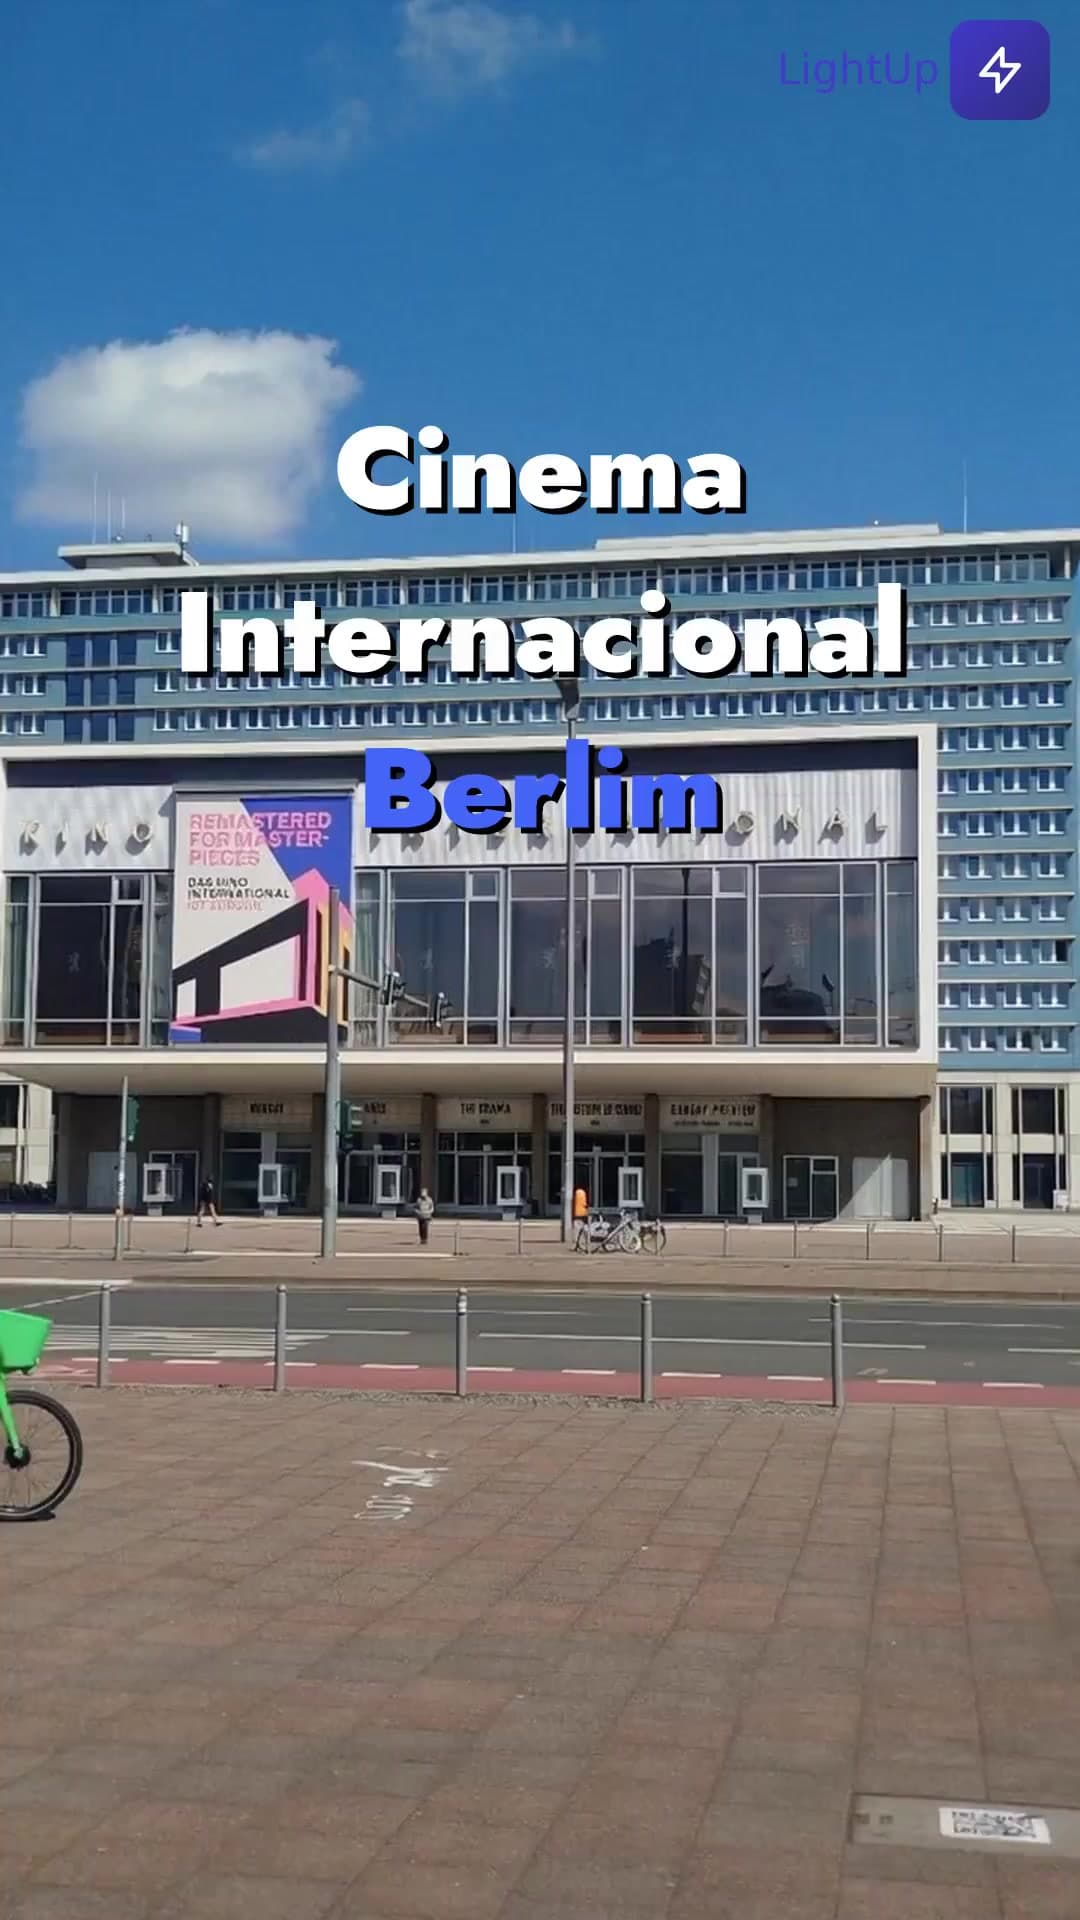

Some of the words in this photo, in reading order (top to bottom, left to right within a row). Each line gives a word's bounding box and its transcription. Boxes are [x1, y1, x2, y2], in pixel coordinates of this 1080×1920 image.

[189, 811, 332, 830] REMASTERED
[189, 831, 229, 849] FOR
[234, 830, 330, 849] MASTER-
[188, 850, 260, 866] PIECES
